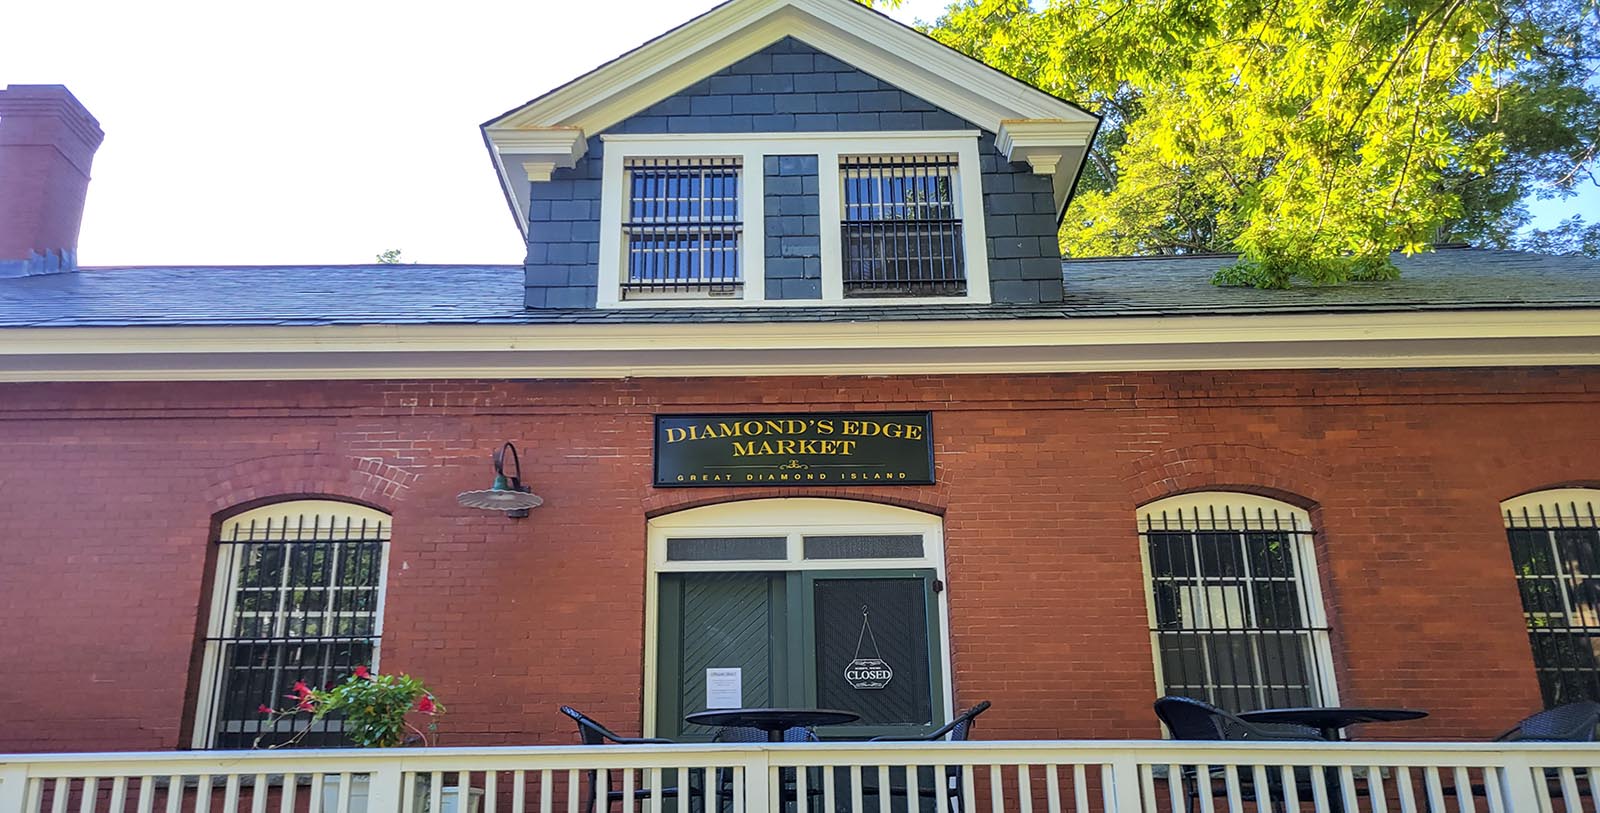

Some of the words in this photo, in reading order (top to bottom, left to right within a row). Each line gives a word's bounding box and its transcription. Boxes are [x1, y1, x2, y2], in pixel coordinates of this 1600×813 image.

[665, 420, 834, 443] DIAMOND'S
[841, 420, 922, 440] EDGE
[732, 439, 856, 457] MARKET
[677, 473, 732, 481] GREAT
[746, 472, 826, 481] DIAMOND
[841, 472, 907, 480] ISLAND
[847, 670, 891, 680] CLOSED
